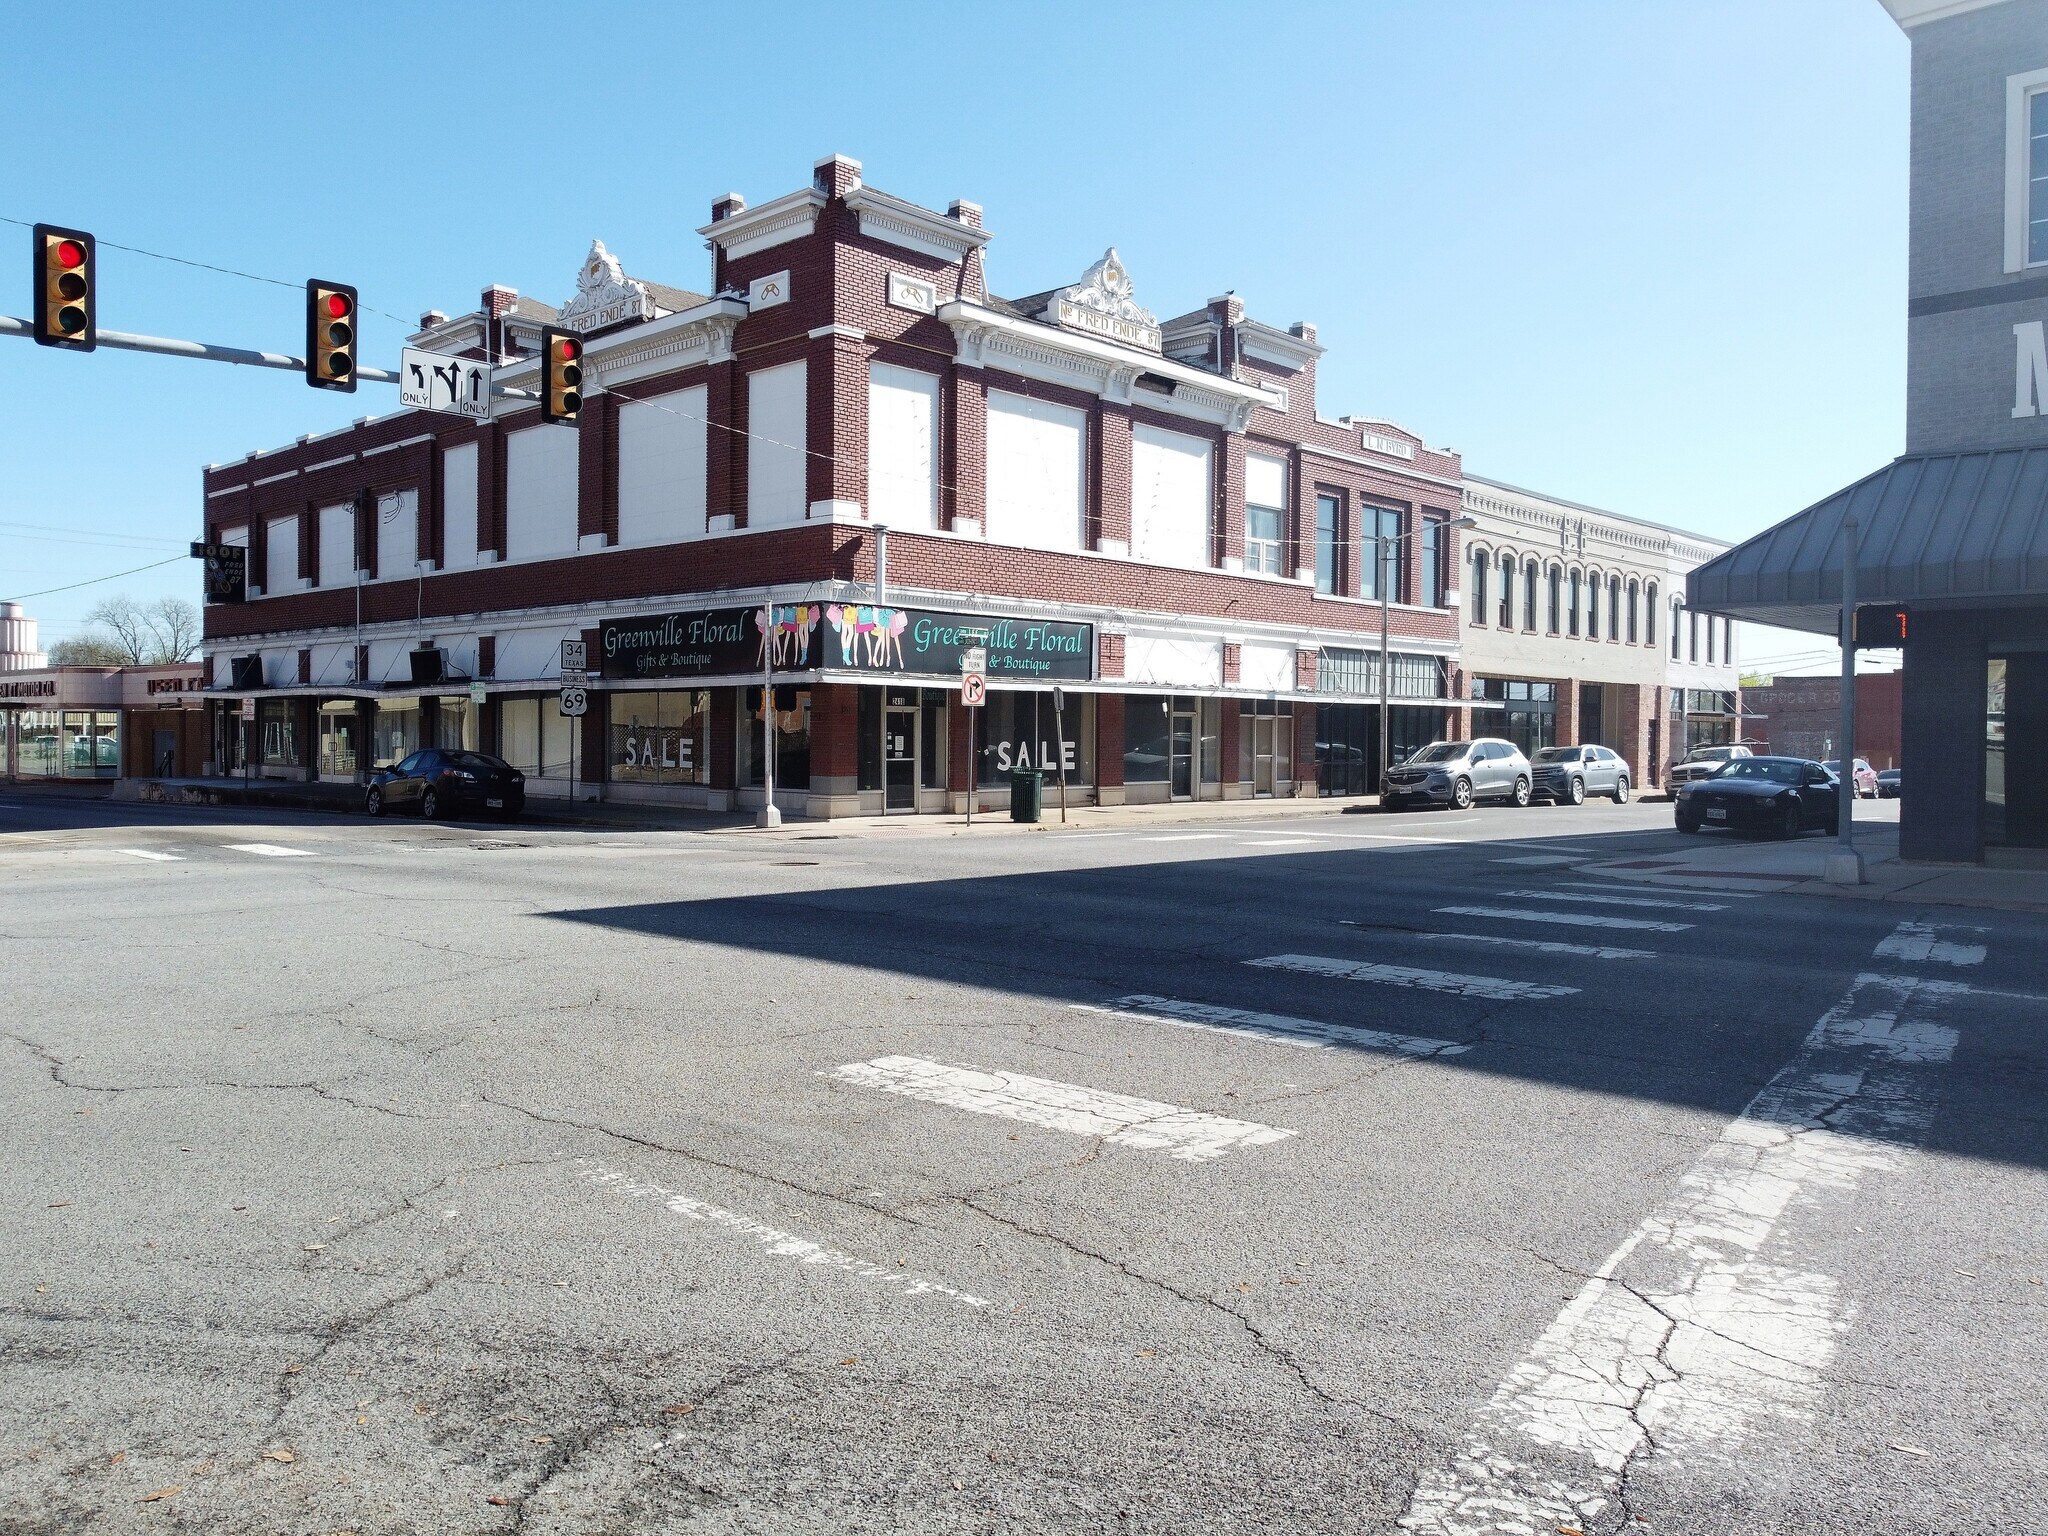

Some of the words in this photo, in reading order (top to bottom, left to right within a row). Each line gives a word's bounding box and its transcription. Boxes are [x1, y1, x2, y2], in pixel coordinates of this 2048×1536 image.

[571, 315, 597, 332] FRED
[600, 304, 625, 322] ENDE
[1078, 309, 1109, 331] FRED
[1113, 321, 1142, 342] ENDE
[403, 393, 428, 404] ONLY
[463, 403, 487, 414] ONLY
[604, 615, 683, 658] Greenville
[688, 609, 749, 645] Floral
[914, 618, 1018, 653] Greeville
[1024, 622, 1088, 654] Floral
[566, 644, 583, 656] 34
[636, 651, 656, 674] Gifts
[658, 653, 669, 667] &
[671, 651, 712, 670] Boutique
[988, 654, 1002, 668] &
[1003, 655, 1051, 676] Boutique
[564, 693, 584, 709] 69
[626, 737, 694, 769] SALE
[997, 741, 1076, 771] SALE
